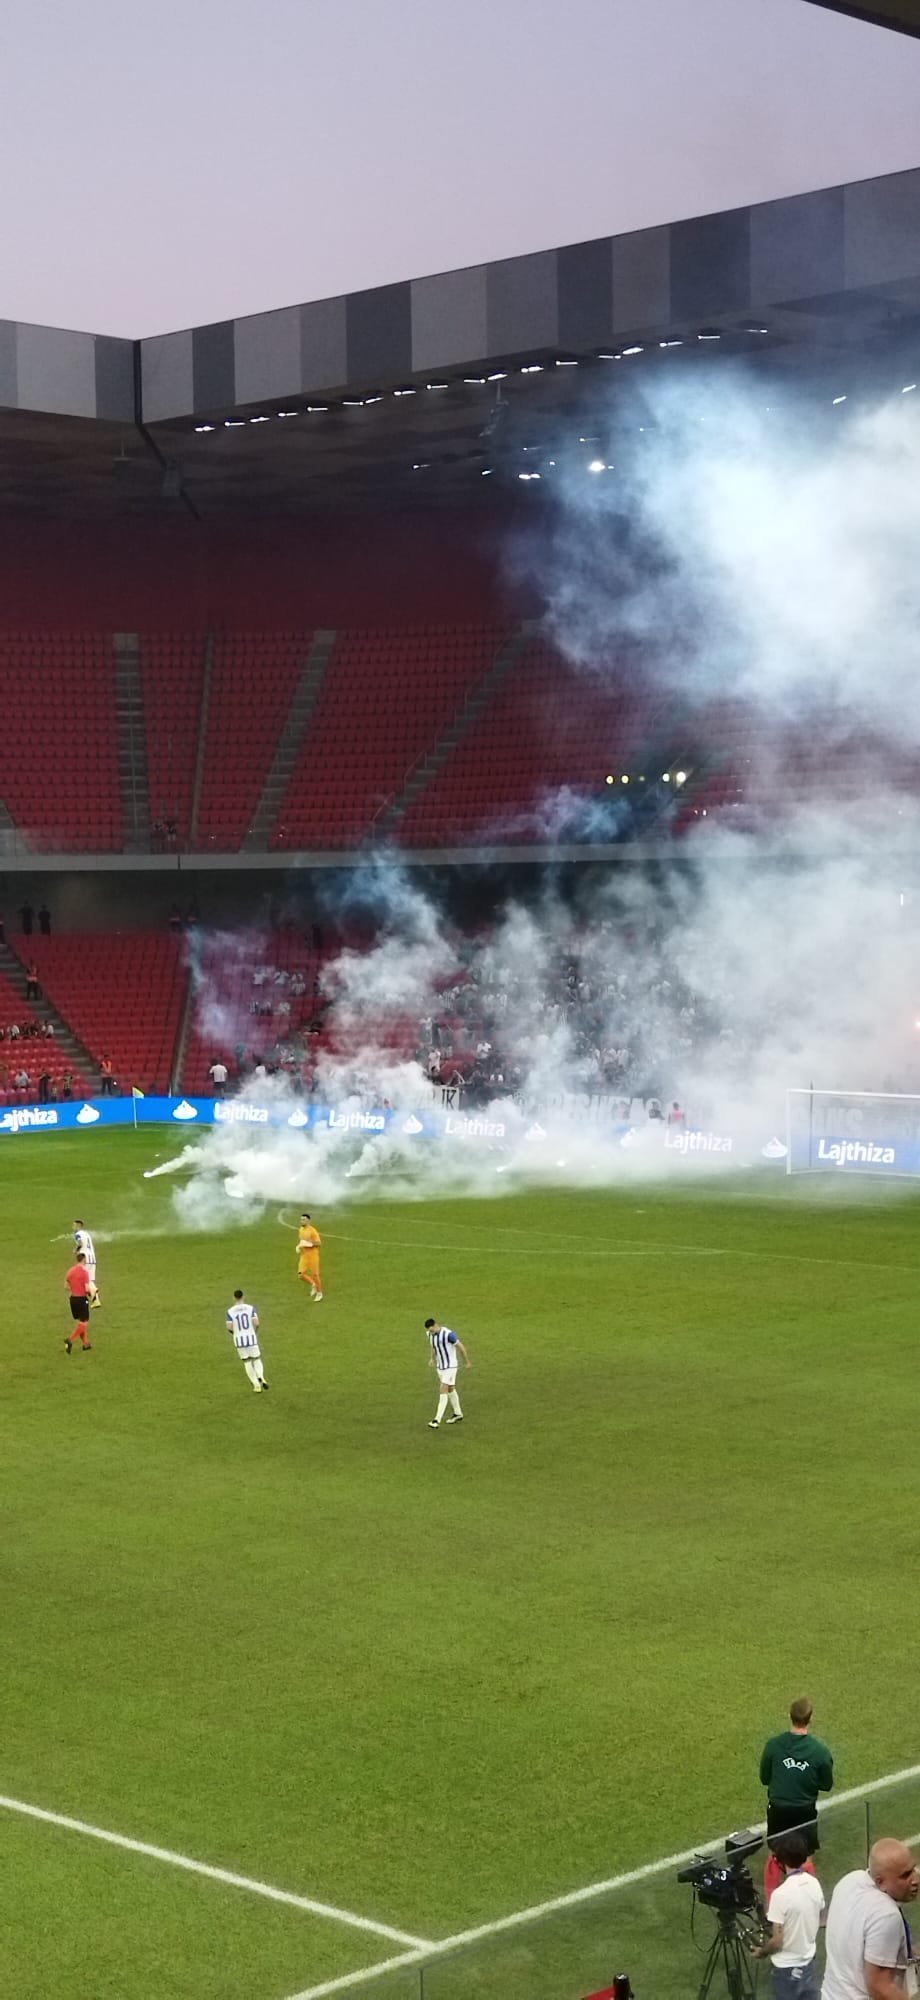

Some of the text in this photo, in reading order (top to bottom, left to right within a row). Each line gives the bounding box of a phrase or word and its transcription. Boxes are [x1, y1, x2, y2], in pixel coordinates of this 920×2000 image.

[214, 1102, 269, 1124] Lajthiza
[329, 1110, 385, 1132] Lajthiza
[445, 1117, 505, 1139] Lajthiza
[664, 1130, 733, 1155] Lajthiza
[818, 1139, 895, 1166] Lajthiza
[235, 1313, 249, 1331] 10
[720, 1870, 727, 1881] 3
